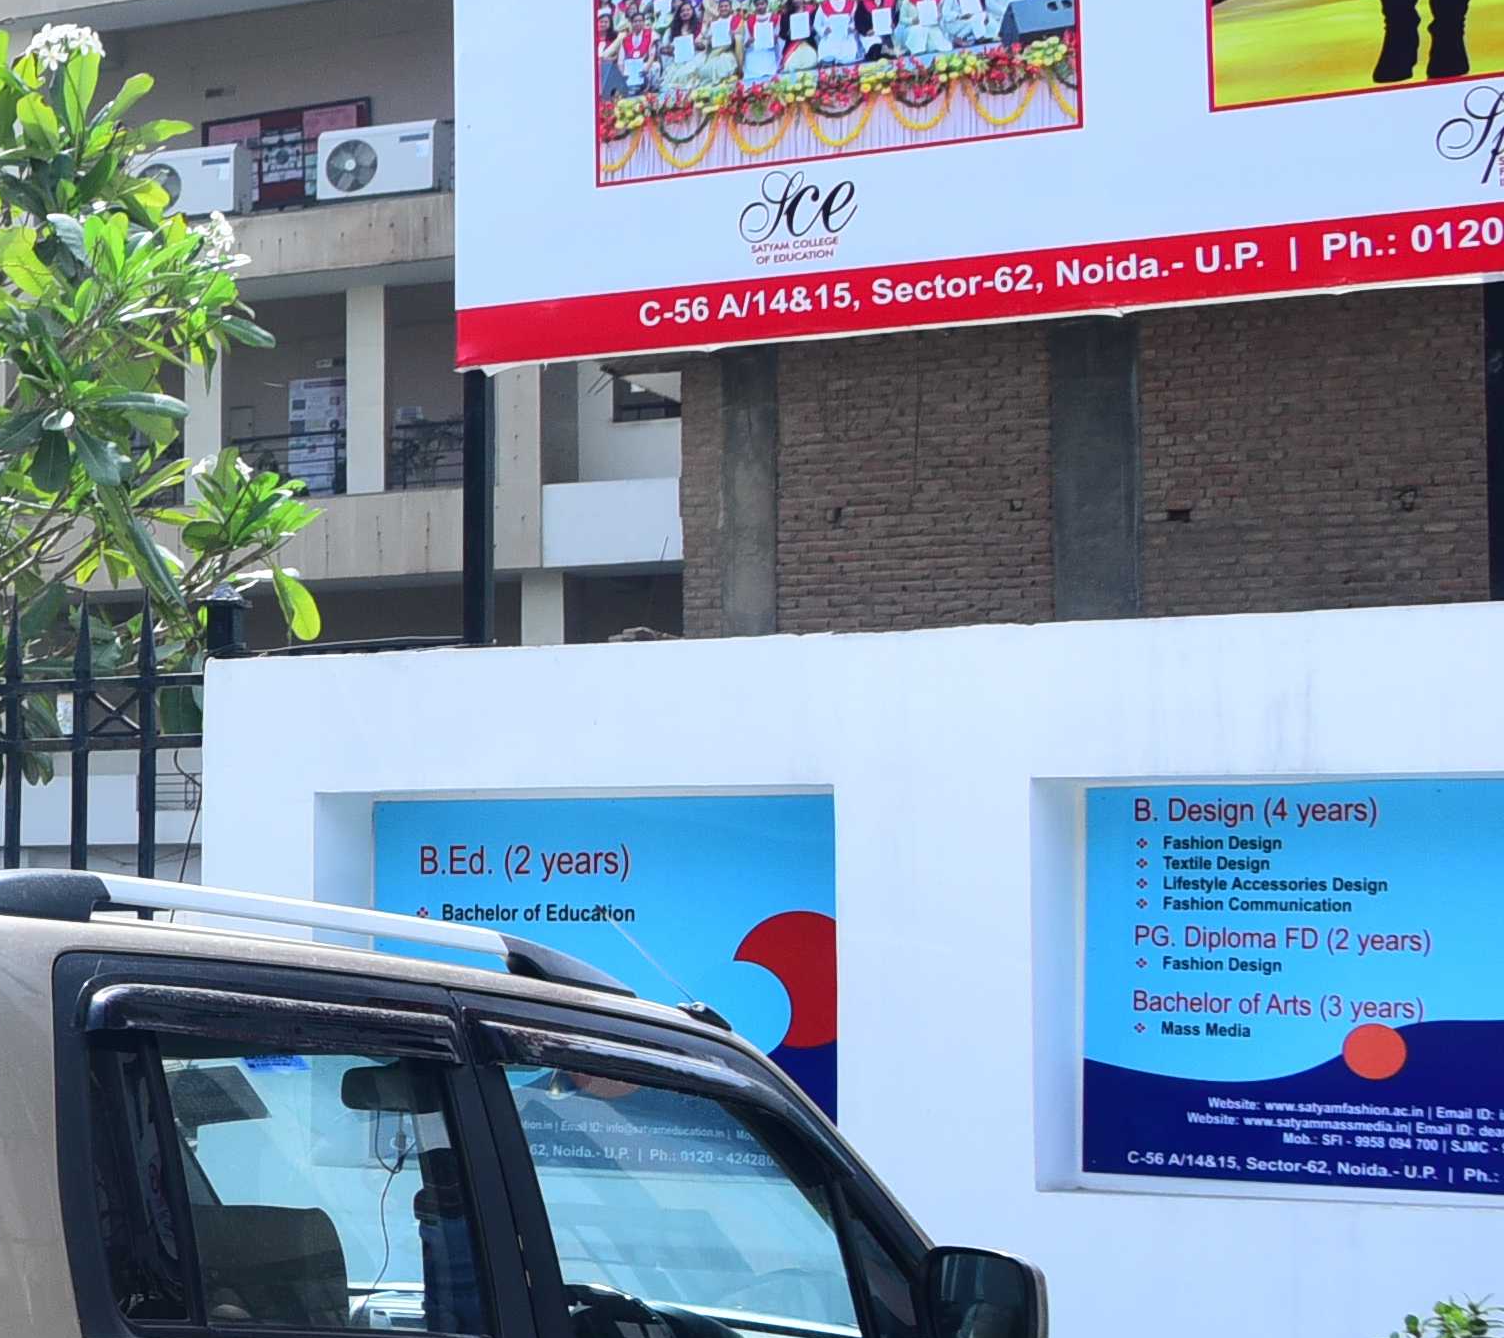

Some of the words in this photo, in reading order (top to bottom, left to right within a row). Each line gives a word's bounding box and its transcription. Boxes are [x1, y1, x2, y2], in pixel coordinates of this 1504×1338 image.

[751, 240, 789, 254] SATYAM
[793, 236, 838, 250] COLLEGE
[757, 255, 771, 265] OF
[773, 250, 834, 263] EDUCATION
[640, 295, 708, 327] C-56
[717, 281, 860, 321] A/14&15,
[872, 264, 1043, 306] Sector-62,
[1195, 242, 1264, 273] U.P.
[1323, 232, 1396, 261] Ph.:
[1411, 217, 1504, 253] 0120
[1134, 798, 1158, 822] B.
[1168, 798, 1254, 828] Design
[1263, 798, 1288, 827] (4
[1296, 797, 1379, 828] years)
[1163, 836, 1223, 850] Fashion
[1228, 836, 1282, 853] Design
[420, 845, 493, 875] B.Ed.
[505, 844, 531, 882] (2
[540, 844, 631, 882] years)
[1163, 856, 1211, 871] Textile
[1217, 856, 1270, 873] Design
[1163, 877, 1227, 894] Lifestyle
[1232, 877, 1327, 892] Accessories
[1333, 877, 1388, 896] Design
[442, 904, 519, 922] Bachelor
[524, 904, 542, 922] of
[547, 904, 635, 922] Education
[1163, 897, 1223, 911] Fashion
[1228, 898, 1352, 913] Communication
[1135, 925, 1175, 949] PG.
[1184, 926, 1276, 954] Diploma
[1285, 927, 1318, 949] FD
[1327, 928, 1349, 955] (2
[1357, 929, 1432, 957] years)
[1163, 956, 1223, 971] Fashion
[1228, 957, 1282, 975] Design
[1133, 990, 1232, 1014] Bachelor
[1239, 994, 1261, 1015] of
[1266, 994, 1312, 1016] Arts
[1320, 995, 1342, 1022] (3
[1350, 997, 1424, 1023] years)
[1161, 1022, 1200, 1036] Mass
[1206, 1023, 1251, 1038] Media
[1208, 1097, 1261, 1111] Website:
[1265, 1099, 1424, 1118] www.satyamfashion.ac.in
[1436, 1107, 1472, 1120] Email
[1477, 1109, 1496, 1121] ID:
[1187, 1112, 1240, 1126] Website:
[1416, 1122, 1452, 1135] Email
[1456, 1124, 1475, 1136] ID:
[1283, 1133, 1319, 1145] Mob.:
[1322, 1134, 1342, 1147] SFI
[1355, 1135, 1385, 1149] 9958
[1389, 1137, 1412, 1150] 094
[1416, 1138, 1438, 1151] 700
[1451, 1139, 1488, 1154] SJMC
[1127, 1151, 1164, 1165] C-56
[1168, 1152, 1241, 1170] A/14&15,
[1246, 1157, 1332, 1175] Sector-62,
[1404, 1165, 1437, 1180] U.P.
